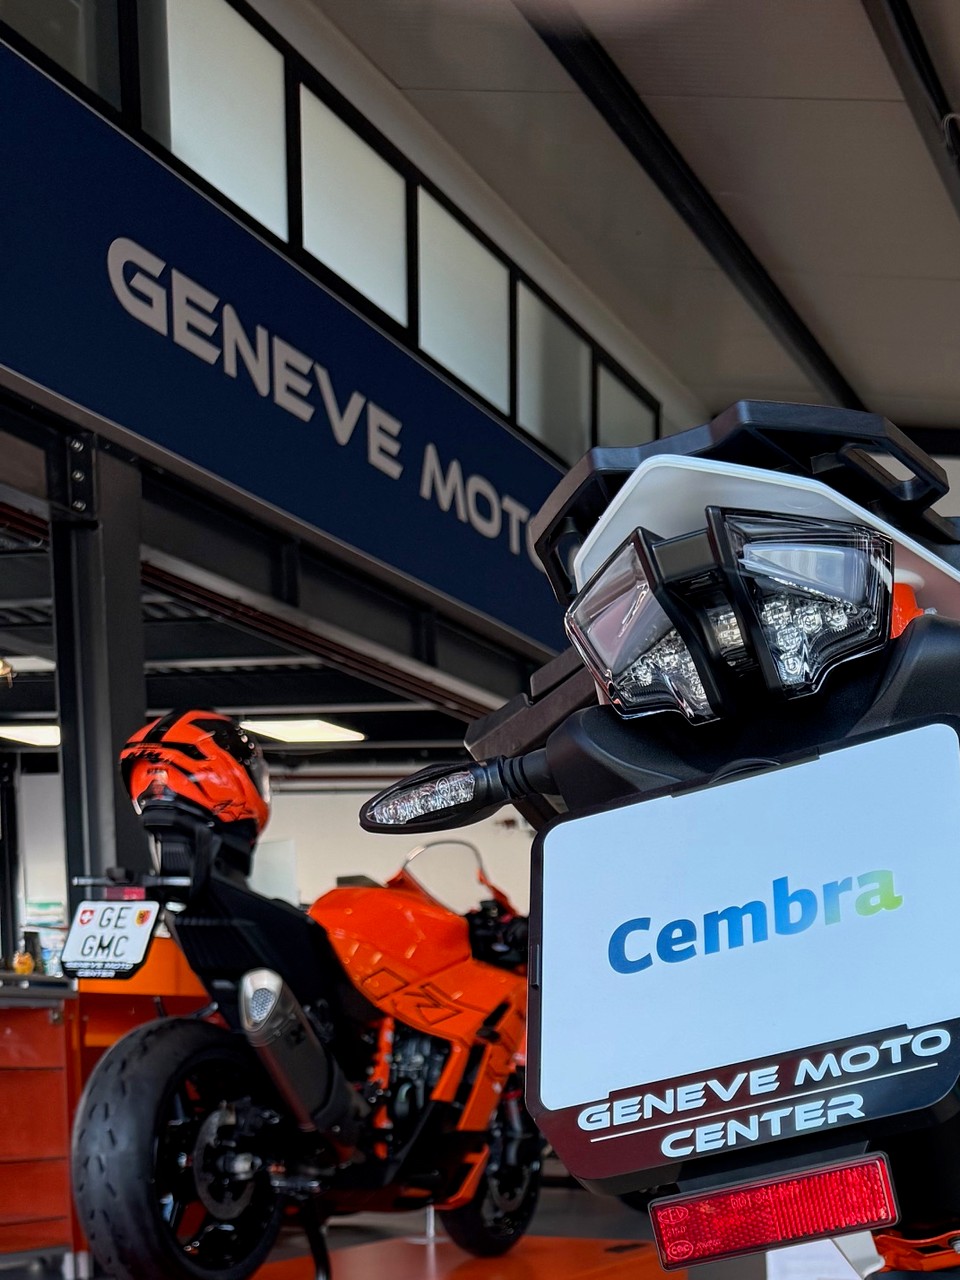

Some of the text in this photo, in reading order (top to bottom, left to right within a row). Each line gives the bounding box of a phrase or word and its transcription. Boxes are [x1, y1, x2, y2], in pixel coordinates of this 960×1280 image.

[107, 237, 404, 480] GENEVE
[80, 935, 129, 958] GMC
[98, 906, 132, 929] GE
[607, 869, 903, 975] Cembra
[577, 1028, 951, 1132] GENEVE MOTO
[660, 1093, 866, 1159] CENTER
